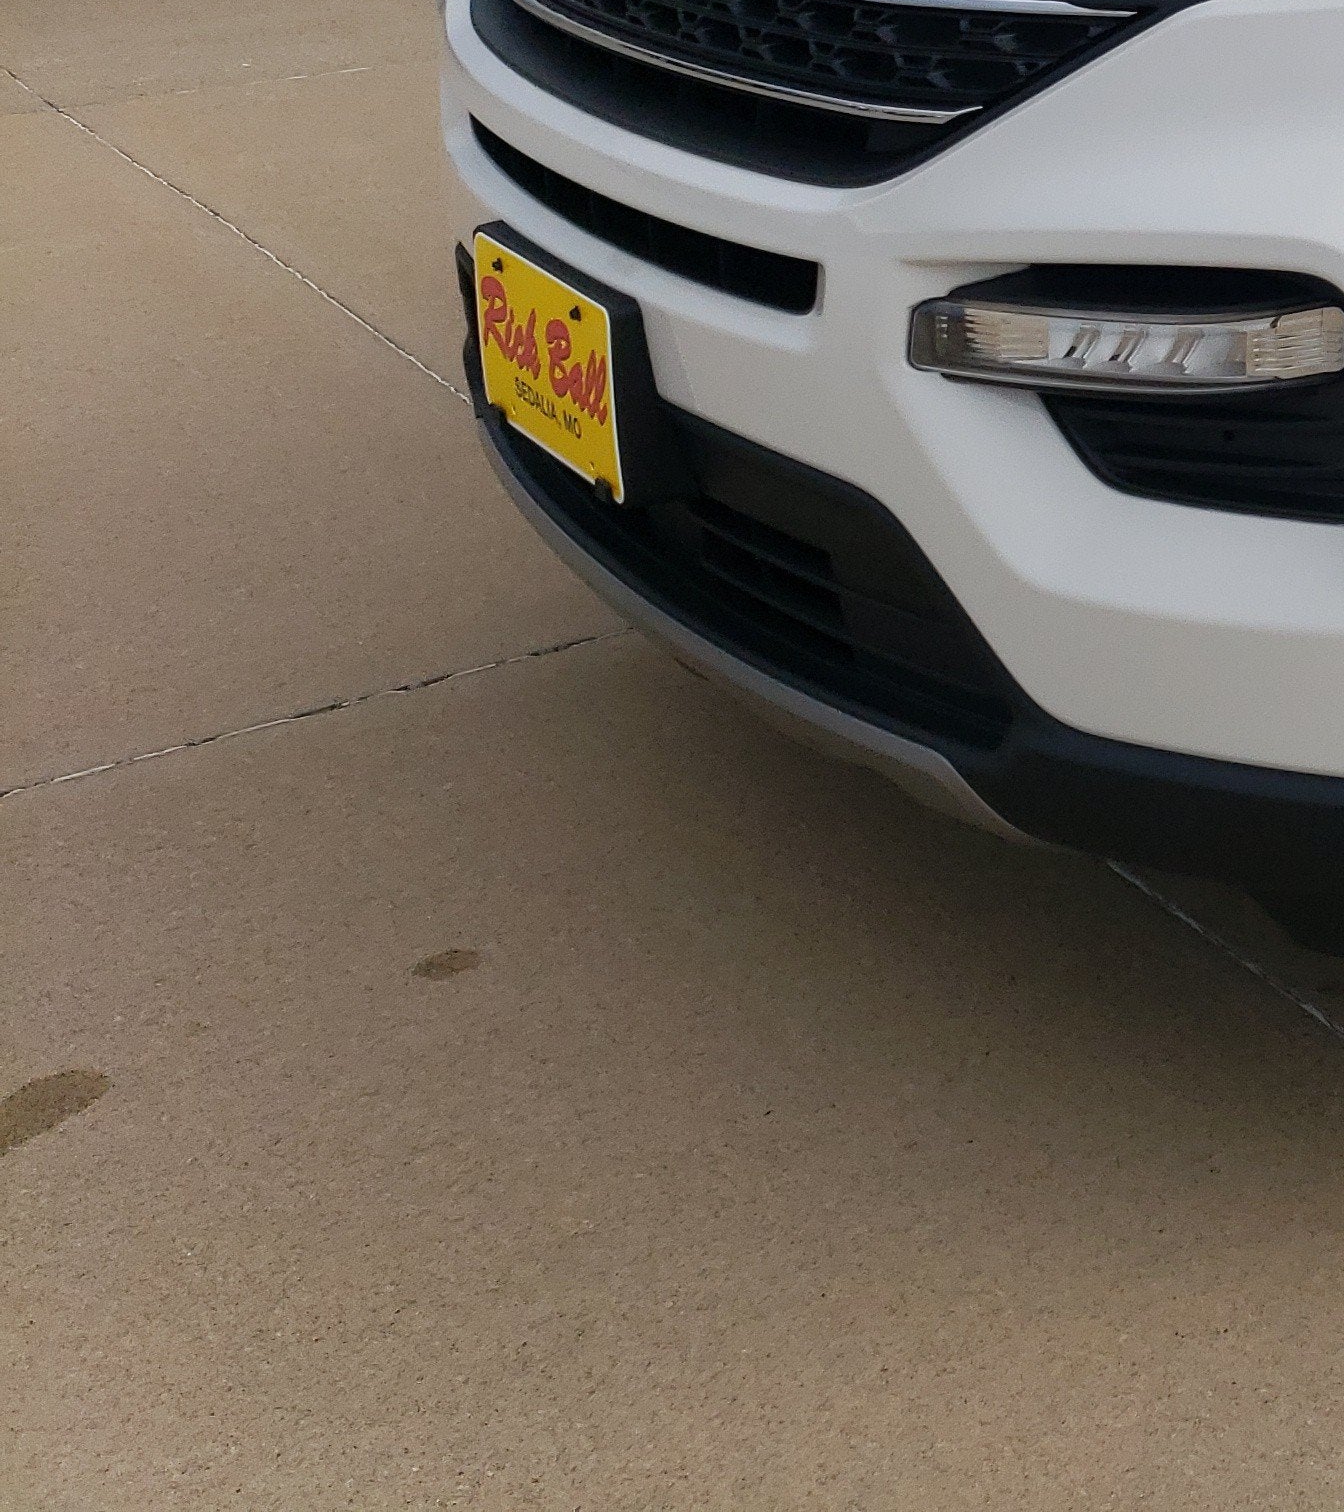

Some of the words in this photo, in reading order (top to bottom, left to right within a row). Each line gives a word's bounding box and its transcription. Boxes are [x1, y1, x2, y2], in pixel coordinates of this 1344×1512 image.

[481, 275, 542, 380] Rick
[546, 319, 608, 427] Ball
[514, 376, 562, 429] SEDALIA,
[563, 410, 583, 440] MO
